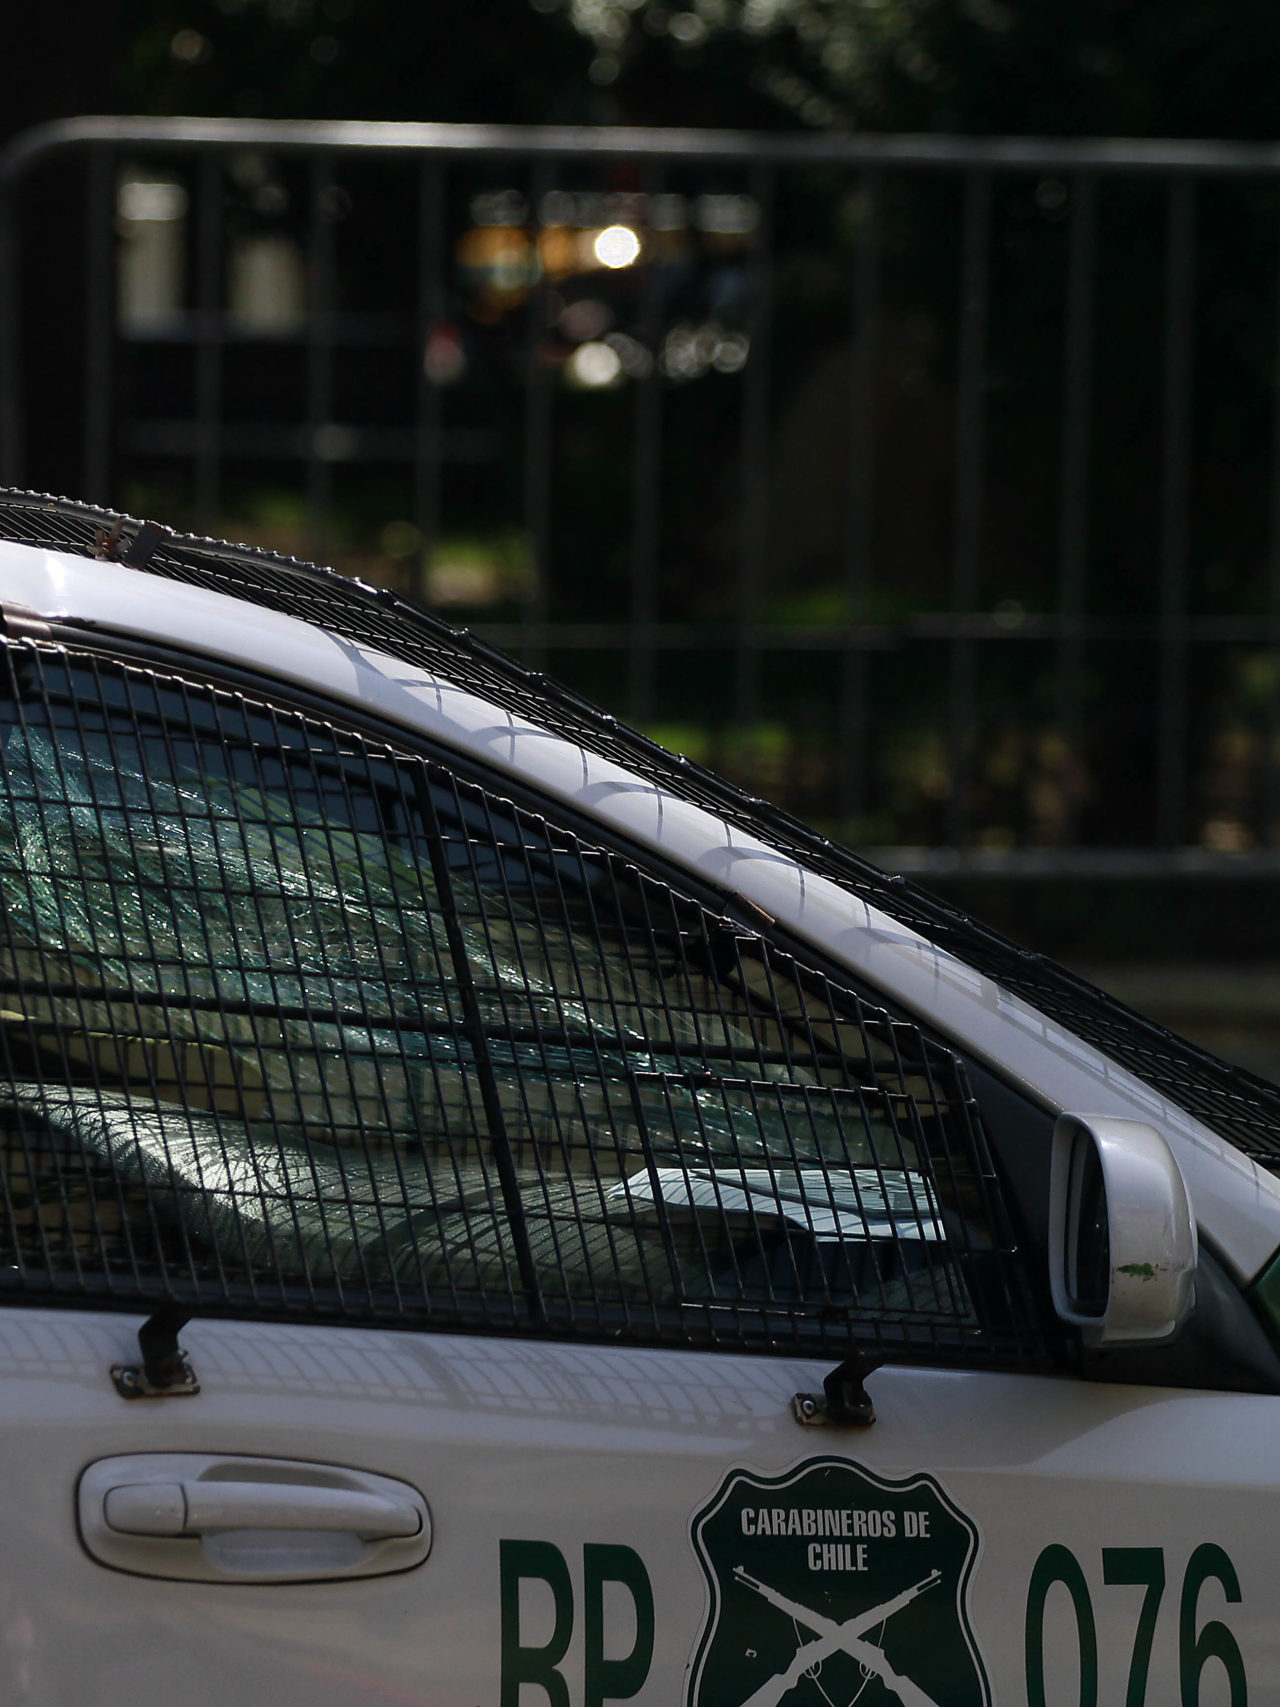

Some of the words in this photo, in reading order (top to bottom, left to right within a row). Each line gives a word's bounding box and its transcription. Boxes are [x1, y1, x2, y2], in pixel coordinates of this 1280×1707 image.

[740, 1507, 897, 1538] CARABINEROS
[903, 1510, 931, 1538] DE
[807, 1542, 868, 1571] CHILE
[1024, 1542, 1248, 1707] 076
